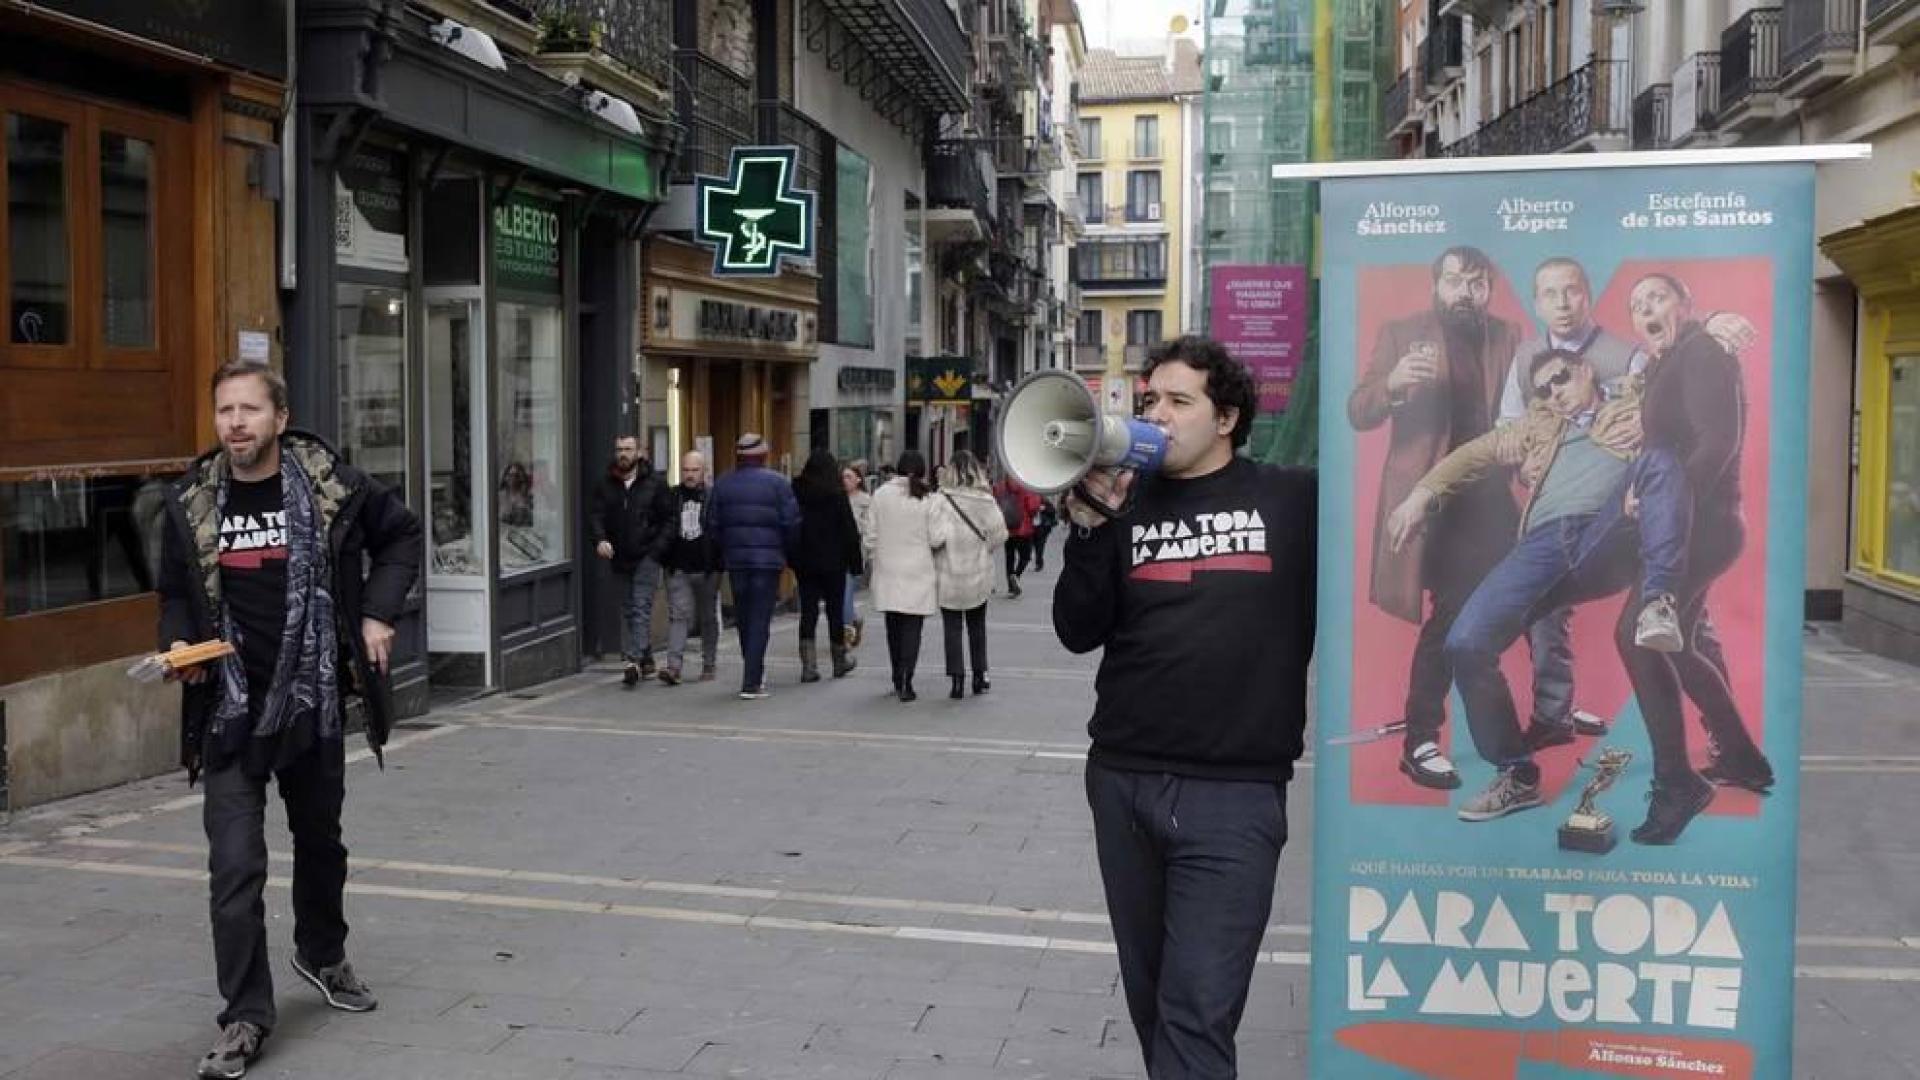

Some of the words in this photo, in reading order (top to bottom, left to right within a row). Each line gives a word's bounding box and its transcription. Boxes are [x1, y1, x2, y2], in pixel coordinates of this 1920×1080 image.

[1364, 201, 1440, 218] Alfonso
[1497, 197, 1575, 215] Alberto
[1648, 192, 1747, 210] Estefanía
[495, 204, 559, 244] ALBERTO
[1356, 218, 1447, 236] Sánchez
[1503, 214, 1568, 233] López
[1621, 212, 1649, 228] de
[1655, 211, 1688, 227] los
[1693, 209, 1774, 226] Santos
[221, 513, 261, 533] ARA
[1132, 519, 1194, 544] PARA
[1196, 508, 1266, 534] TODA
[1132, 543, 1153, 566] LA
[1449, 864, 1478, 879] POR
[1480, 865, 1504, 879] UN
[1506, 867, 1584, 882] TRABAJO
[1589, 870, 1628, 884] PARA
[1631, 871, 1678, 885] TODA
[1681, 873, 1702, 886] LA
[1706, 874, 1759, 889] VIDA?
[1349, 886, 1532, 951] PARA
[1544, 893, 1744, 960] TODA
[1347, 954, 1411, 1012] LA
[1589, 1048, 1651, 1066] Alfonso
[1655, 1053, 1725, 1074] Sánchez
